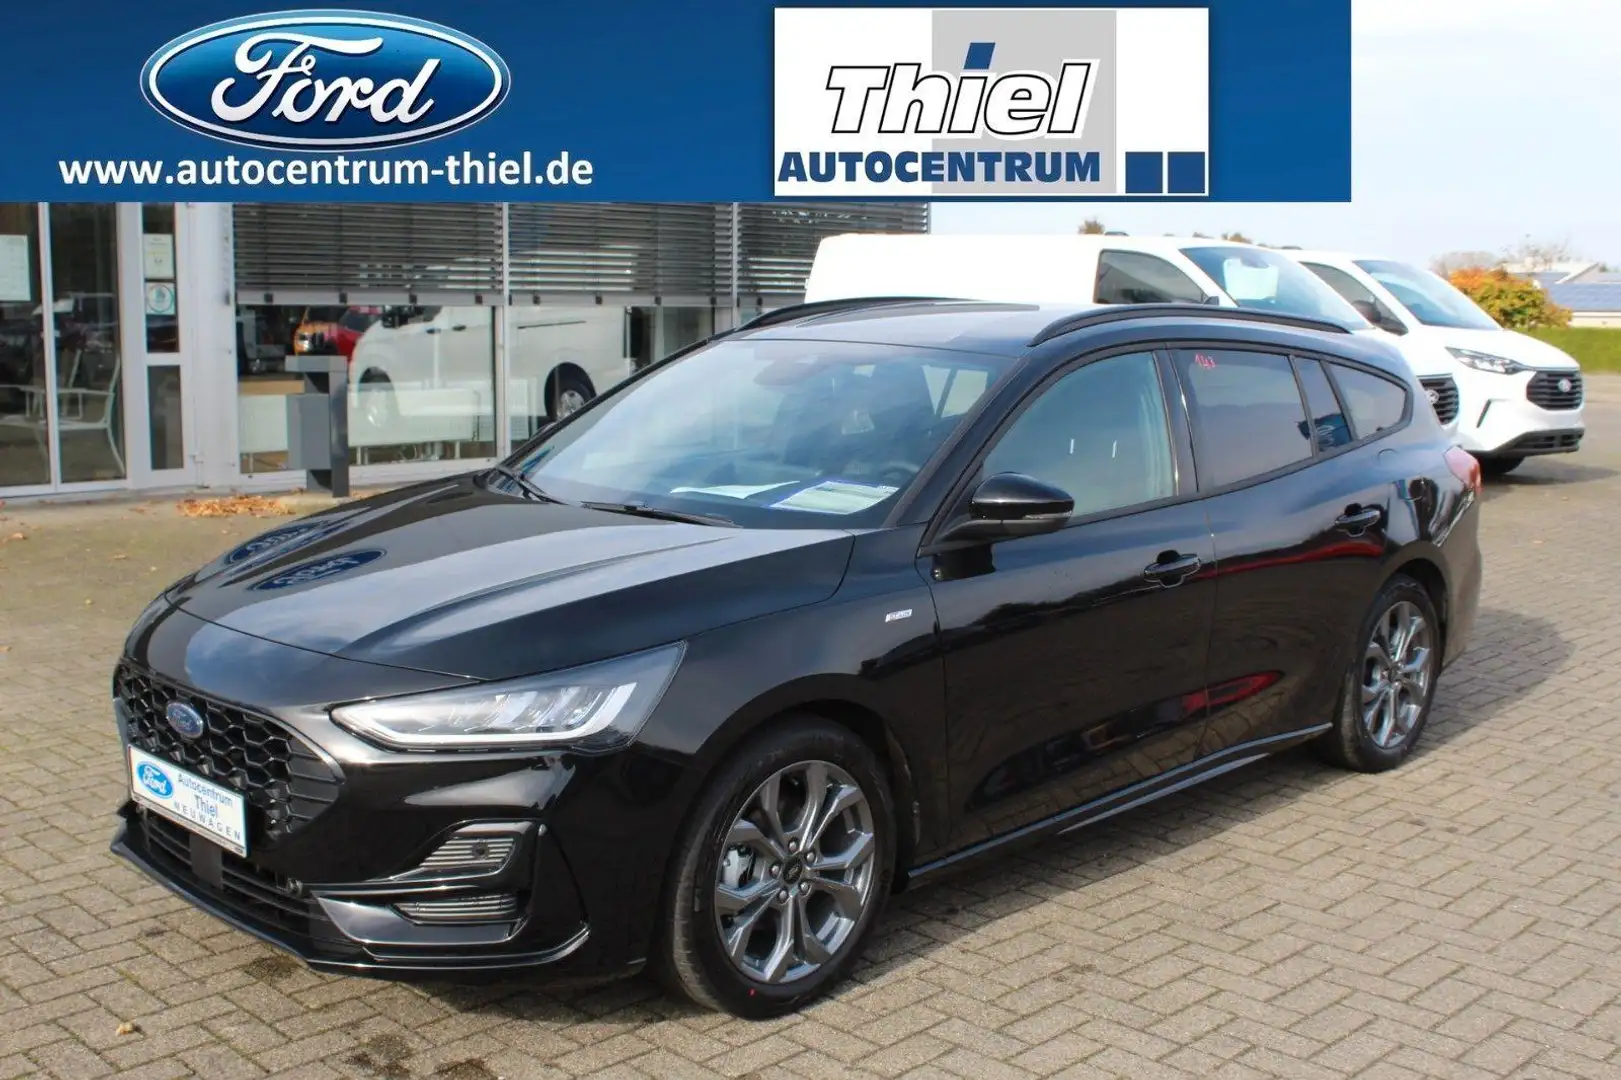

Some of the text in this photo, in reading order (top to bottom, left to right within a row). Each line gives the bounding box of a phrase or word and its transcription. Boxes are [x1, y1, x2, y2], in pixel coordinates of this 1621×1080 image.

[142, 766, 168, 793] Ford
[177, 773, 234, 806] Autocentrum
[194, 794, 219, 817] Thiel
